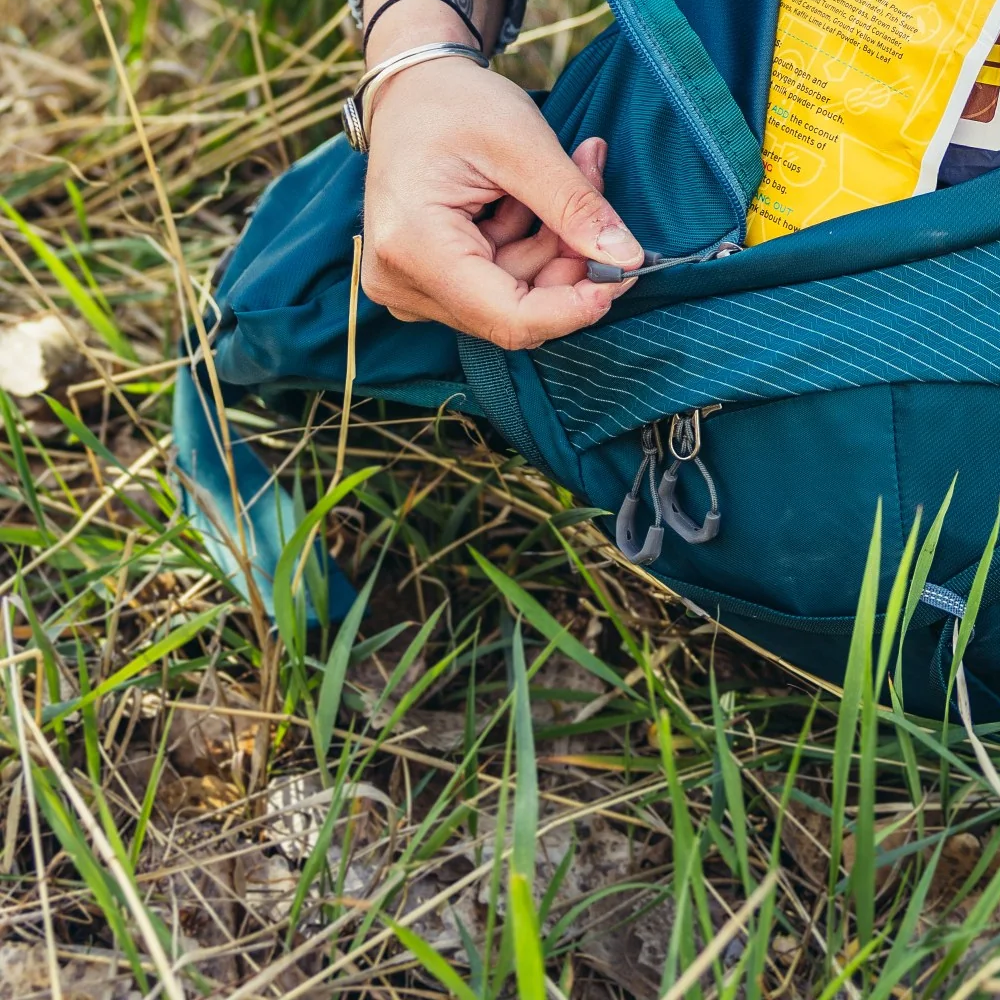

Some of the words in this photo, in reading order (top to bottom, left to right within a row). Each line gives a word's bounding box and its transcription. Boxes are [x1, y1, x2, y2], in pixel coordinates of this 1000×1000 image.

[884, 12, 898, 23] Fish
[898, 20, 918, 33] Sauce
[888, 4, 913, 19] Powder
[802, 1, 831, 21] Cardamom,
[832, 17, 854, 33] Ground
[855, 28, 875, 44] Yellow
[876, 40, 903, 59] Mustard
[808, 15, 822, 27] Lime
[822, 22, 836, 33] Leaf
[835, 30, 861, 49] Powder,
[862, 44, 875, 56] Bay
[875, 51, 891, 63] Leaf
[848, 14, 871, 30] Ground
[871, 26, 901, 49] Coriander,
[870, 15, 890, 29] Brown
[890, 26, 910, 41] Sugar,
[770, 69, 795, 86] oxygen
[796, 82, 830, 103] absorber
[771, 56, 793, 70] pouch
[793, 67, 811, 80] open
[811, 77, 828, 88] and
[773, 84, 787, 96] milk
[787, 92, 815, 109] powder
[815, 106, 844, 124] pouch.
[767, 115, 780, 127] the
[780, 124, 814, 145] contents
[816, 142, 826, 150] of
[770, 105, 788, 118] ADD
[789, 113, 802, 126] the
[803, 122, 838, 143] coconut
[782, 159, 801, 173] cups
[771, 179, 787, 194] bag.
[753, 191, 771, 205] ANG
[773, 201, 794, 216] OUT
[759, 209, 781, 225] about
